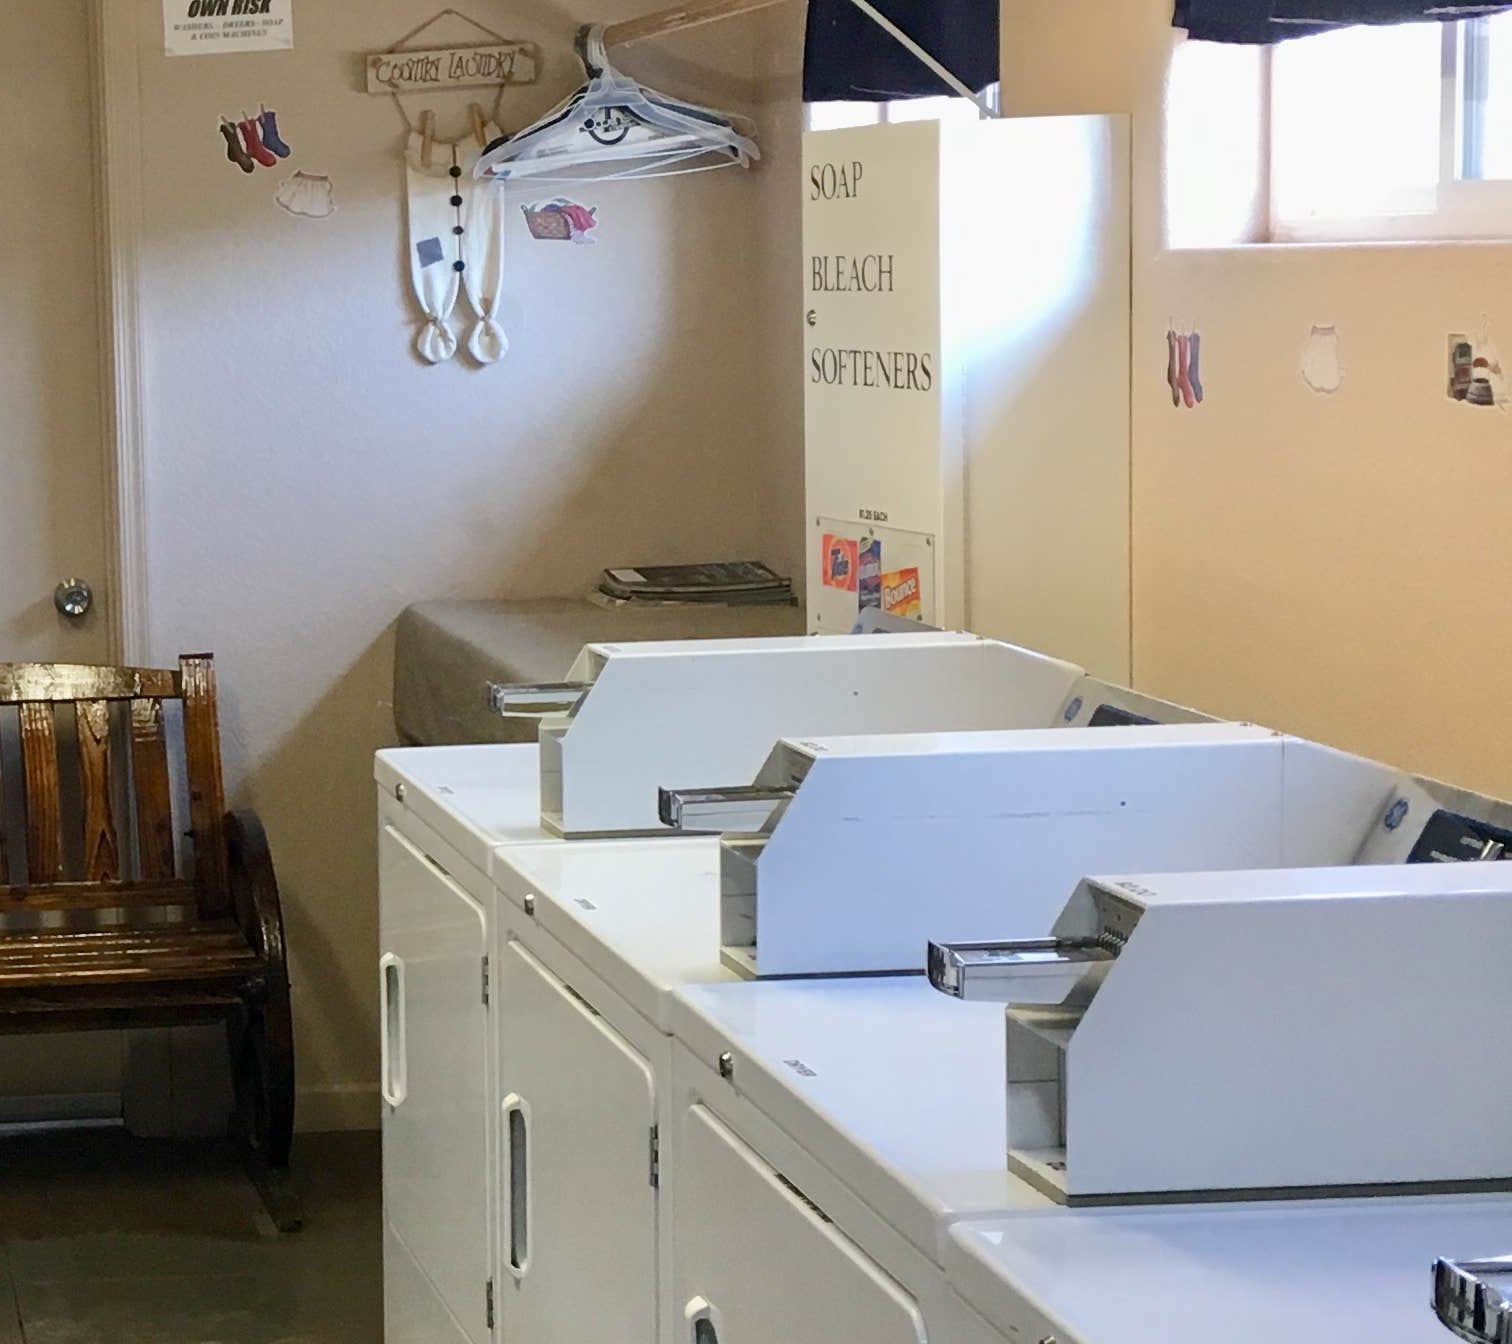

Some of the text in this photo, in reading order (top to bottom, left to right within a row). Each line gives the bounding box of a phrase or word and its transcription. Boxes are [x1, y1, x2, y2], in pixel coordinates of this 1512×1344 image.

[810, 161, 863, 201] SOAP
[811, 254, 894, 292] BLEACH
[811, 347, 932, 392] SOFTENERS
